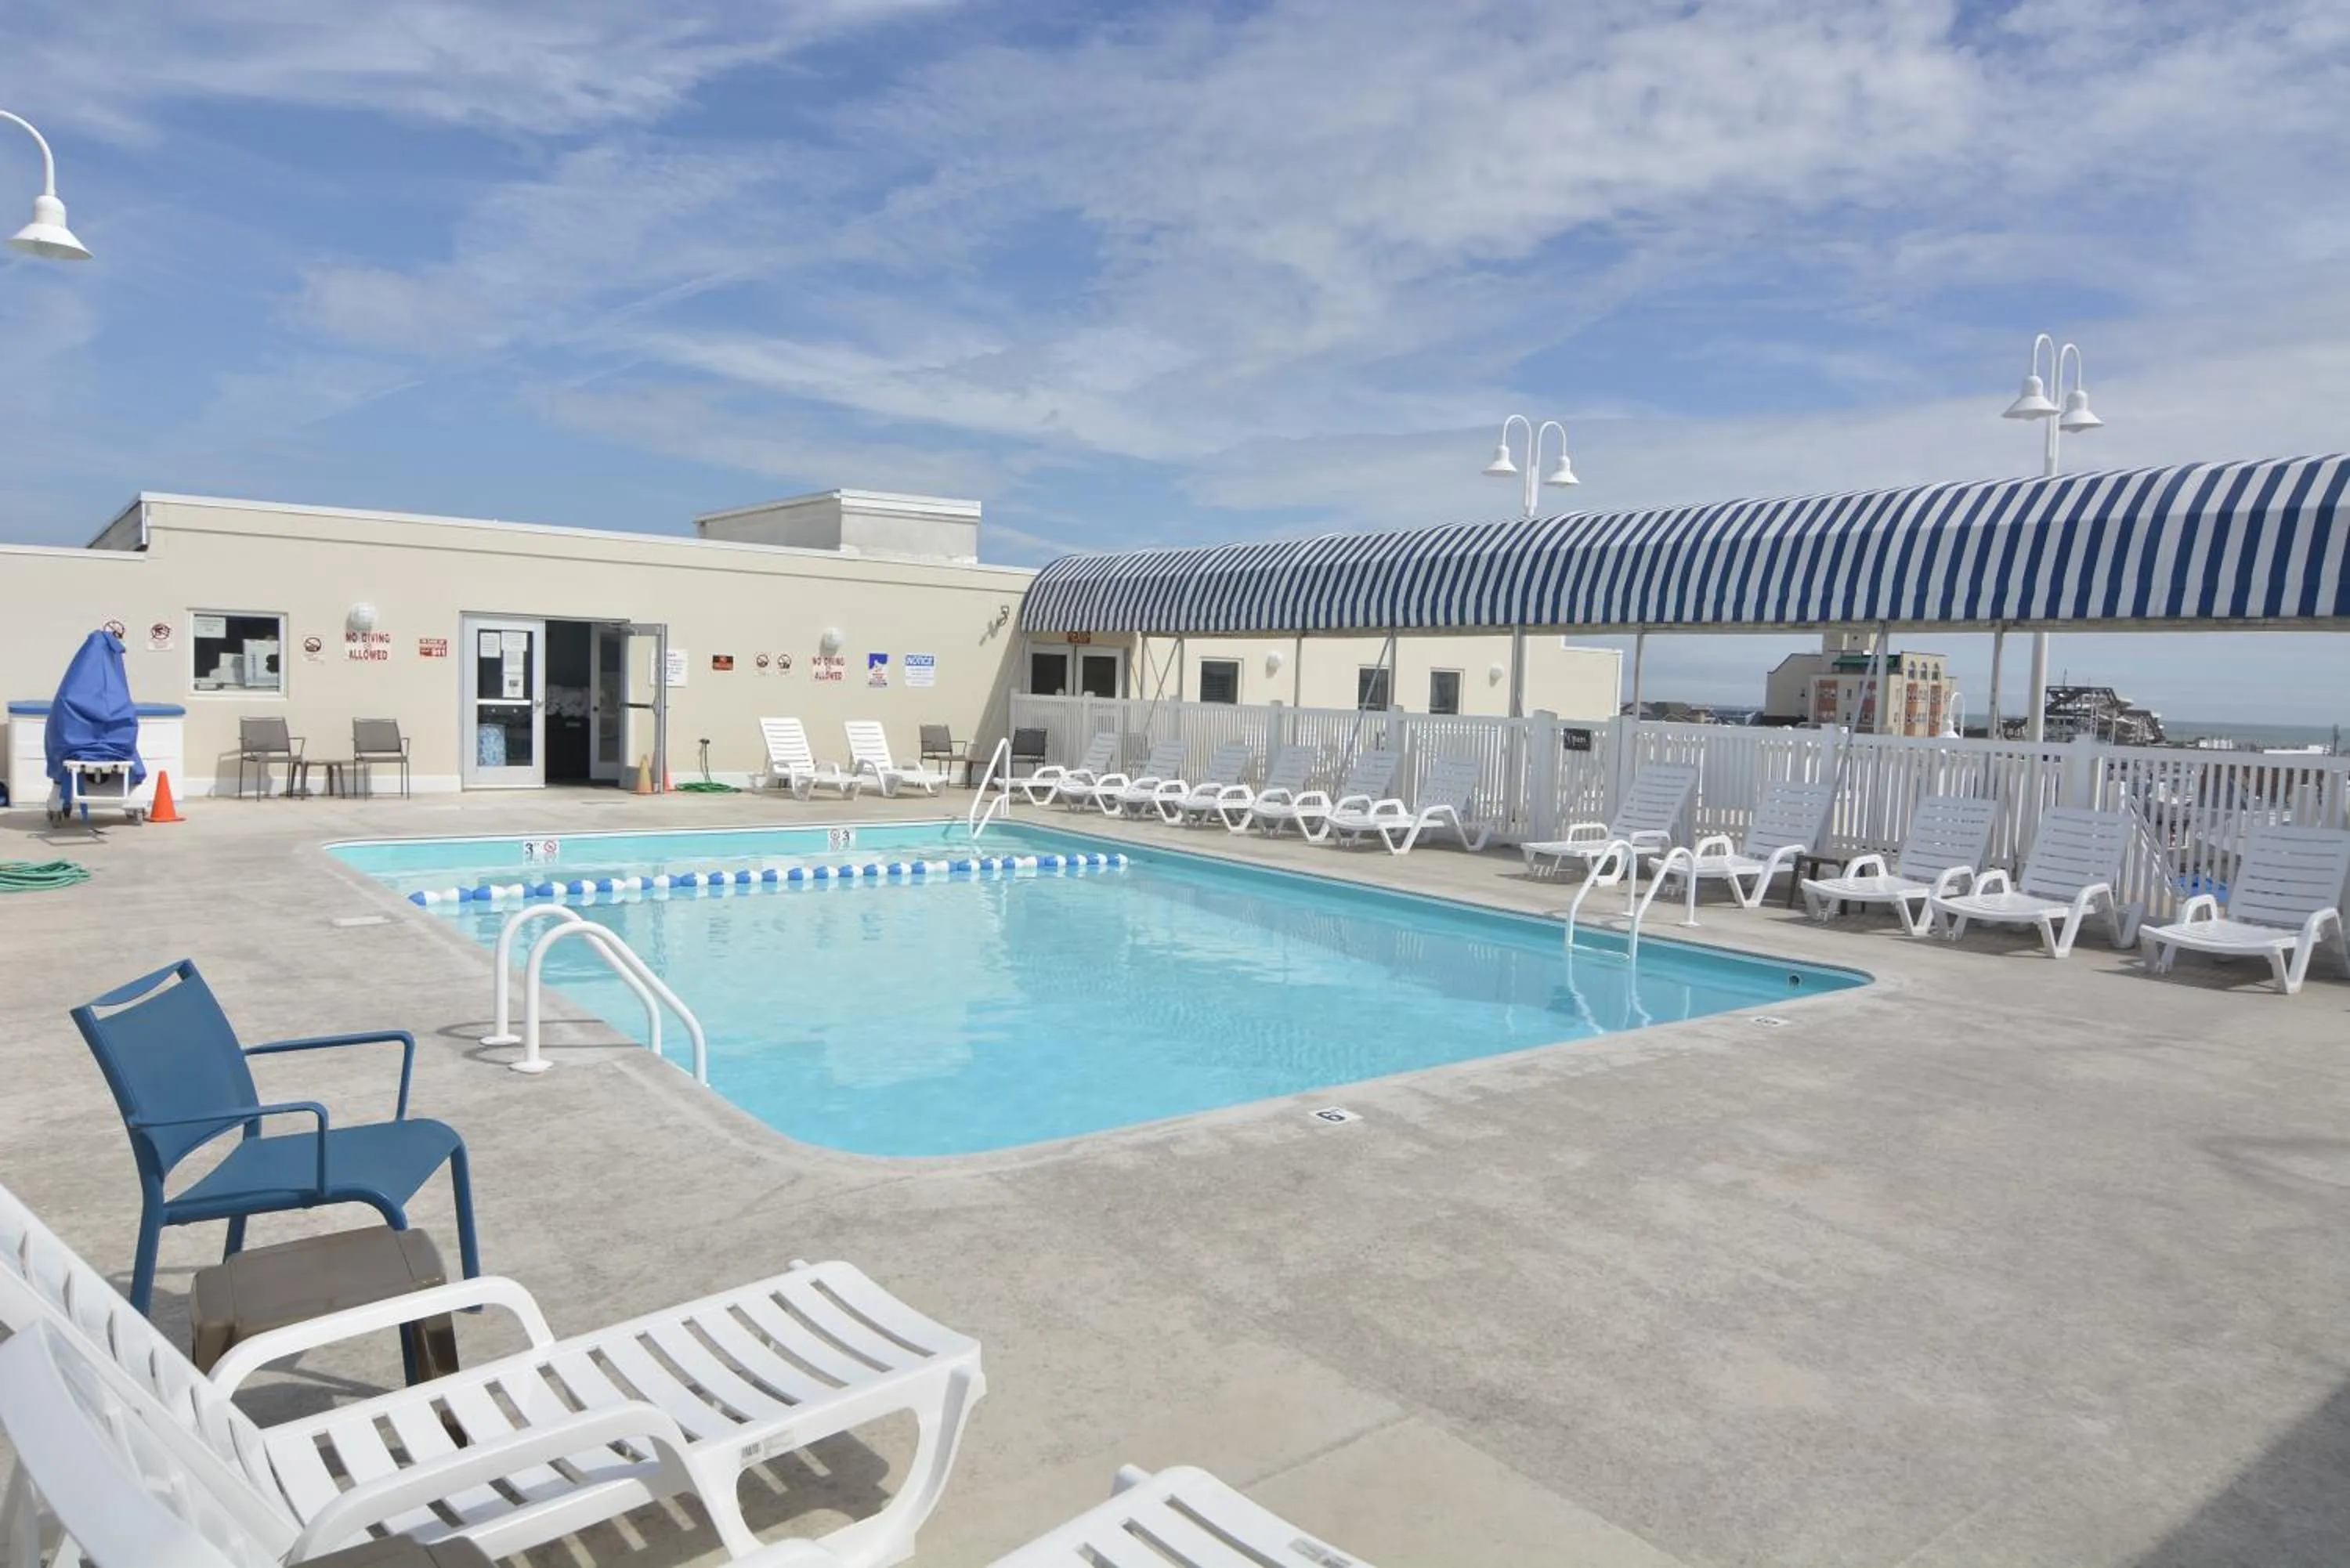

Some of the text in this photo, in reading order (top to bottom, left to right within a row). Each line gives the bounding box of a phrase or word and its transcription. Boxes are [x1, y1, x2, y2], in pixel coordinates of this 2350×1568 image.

[345, 632, 390, 643] NO DIVING
[349, 649, 388, 660] ALLOWED
[906, 656, 933, 666] NOTICE
[843, 830, 850, 840] 3
[526, 843, 533, 854] 3
